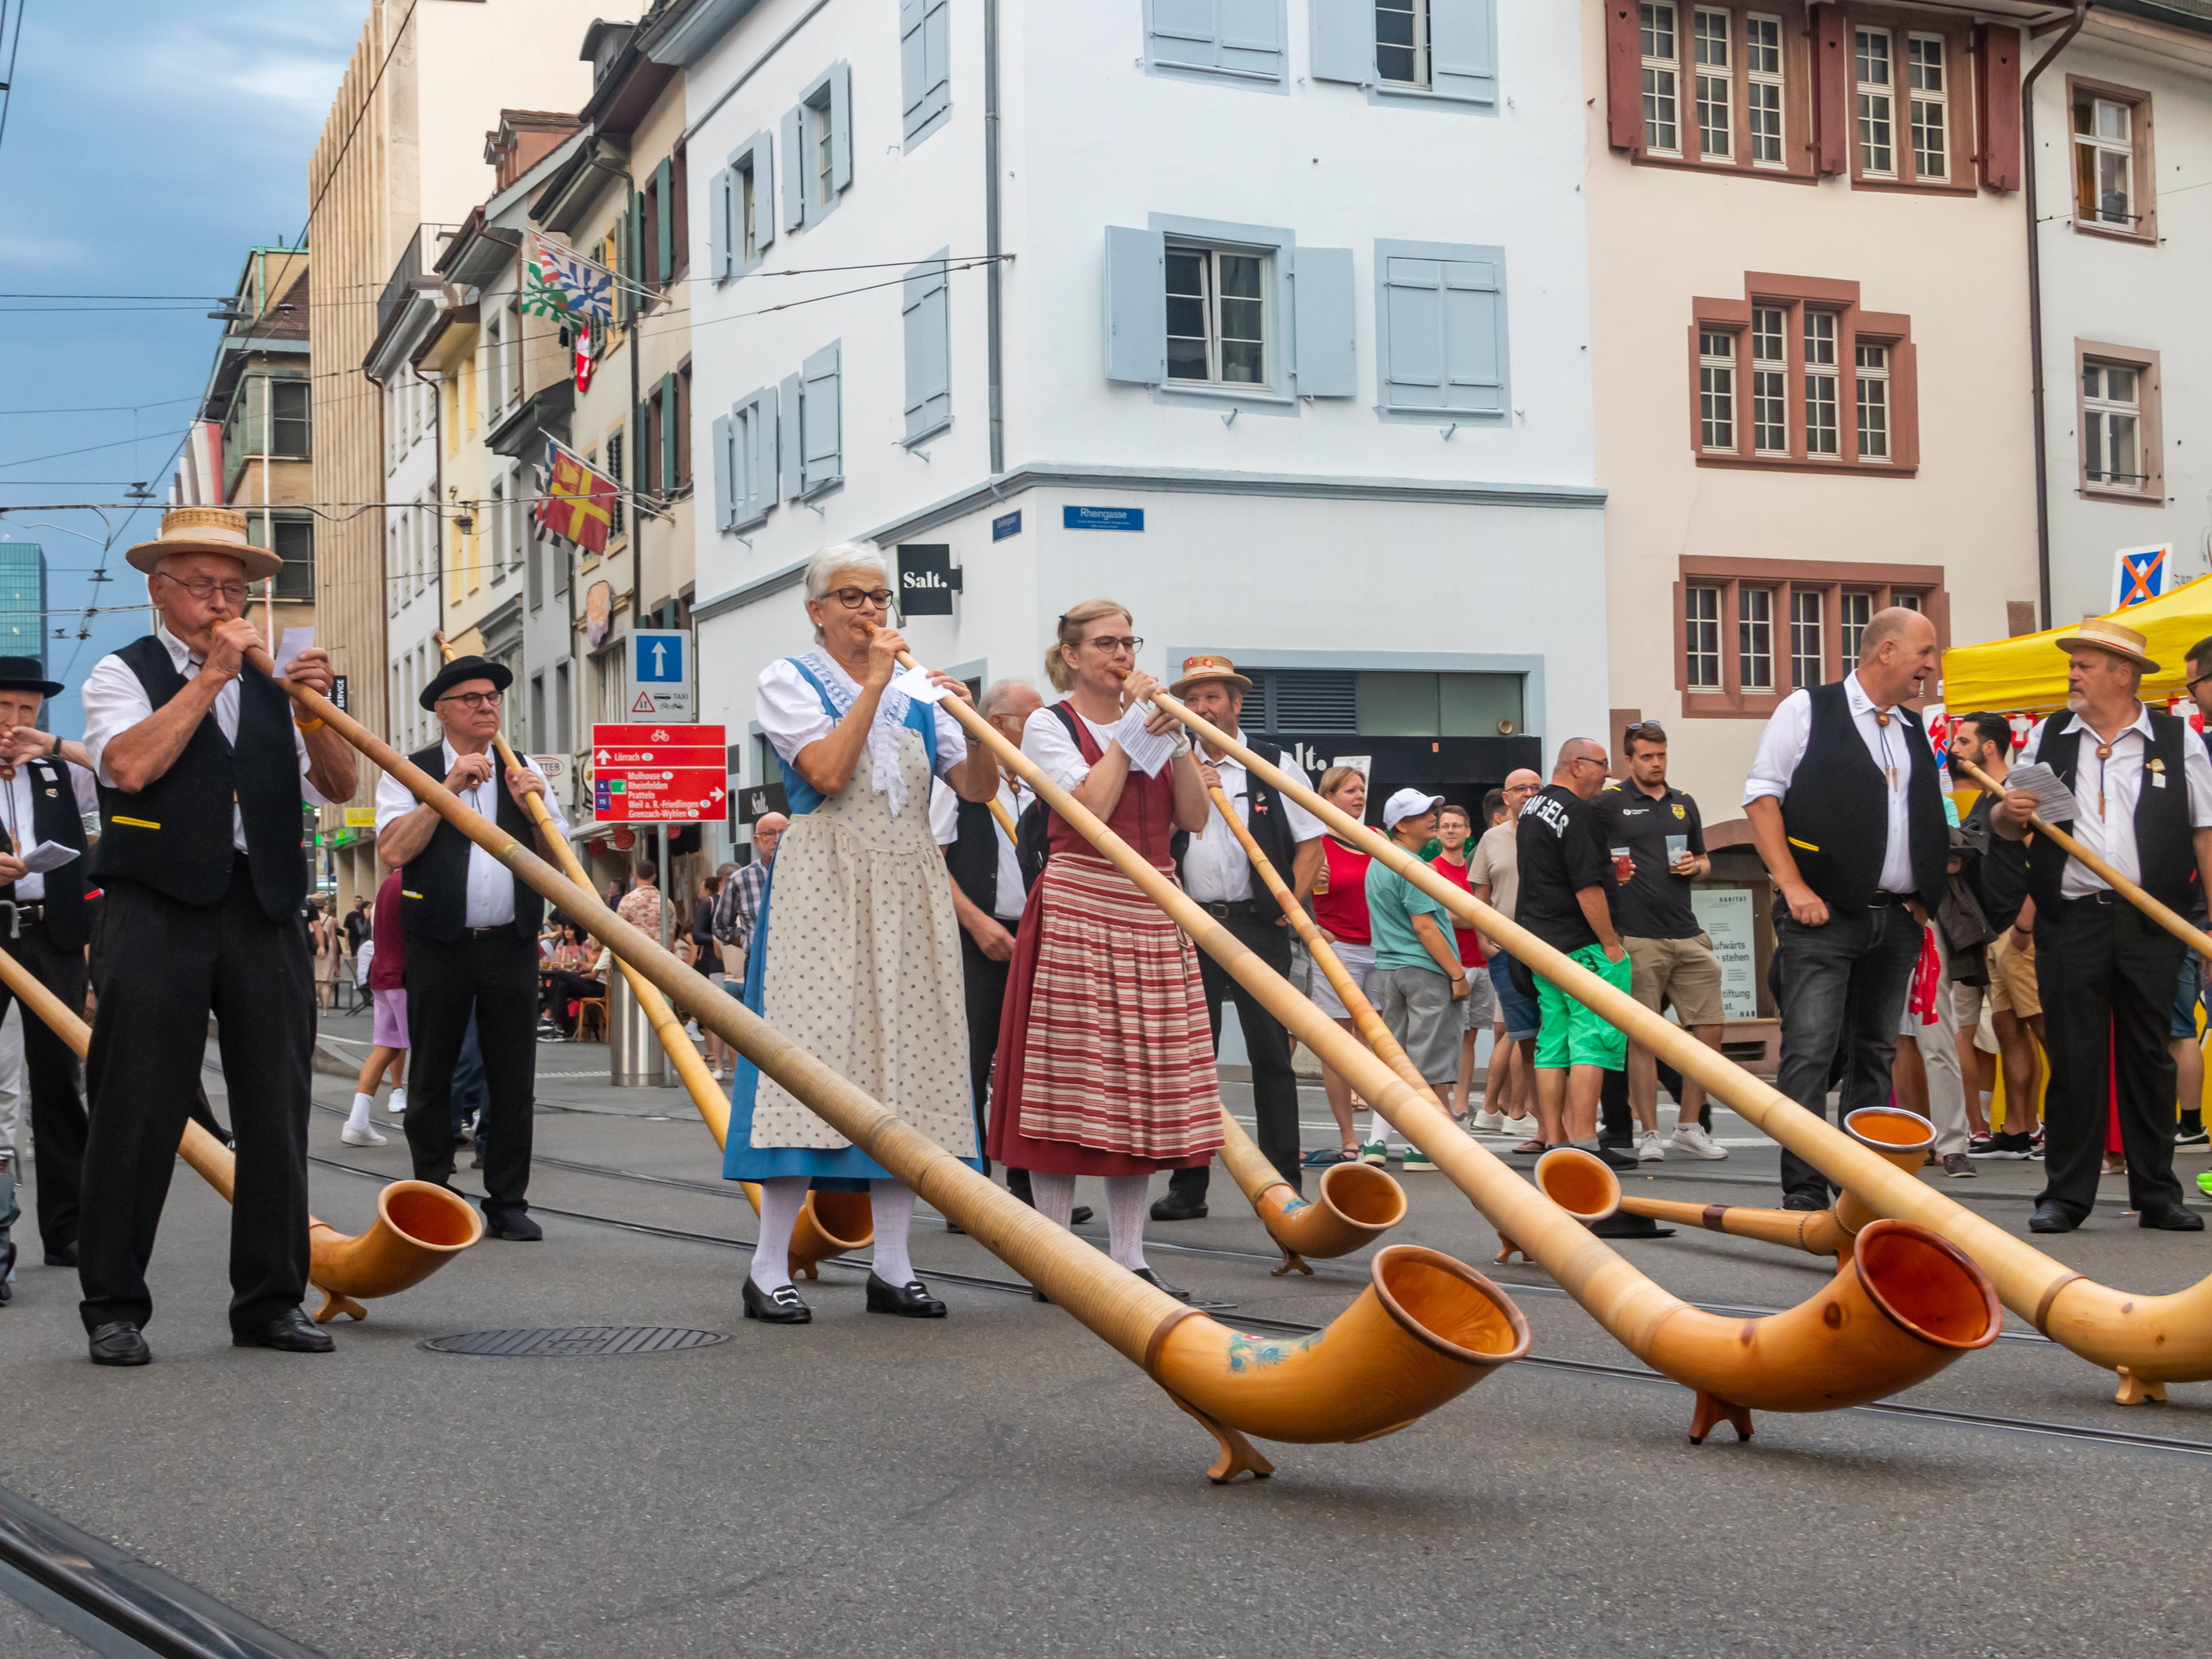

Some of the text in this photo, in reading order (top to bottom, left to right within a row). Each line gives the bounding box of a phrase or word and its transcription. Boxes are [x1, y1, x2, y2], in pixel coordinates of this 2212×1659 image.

[1080, 507, 1127, 520] Rheingasse
[903, 571, 947, 588] Salt.
[337, 679, 345, 708] SERVICE
[614, 752, 640, 761] Lörrach
[1284, 742, 1327, 771] lt.
[539, 763, 560, 772] TTER
[627, 771, 660, 780] Mulhouse
[628, 781, 668, 790] Rheinfelden
[628, 790, 655, 799] Pratteln
[628, 799, 644, 808] Weil
[653, 799, 699, 811] R.-Friedlingen
[628, 809, 687, 820] Grenzach-Wyhlen
[1713, 941, 1746, 951] ufwärts
[1722, 952, 1750, 962] stehen
[1722, 989, 1750, 999] tiftung
